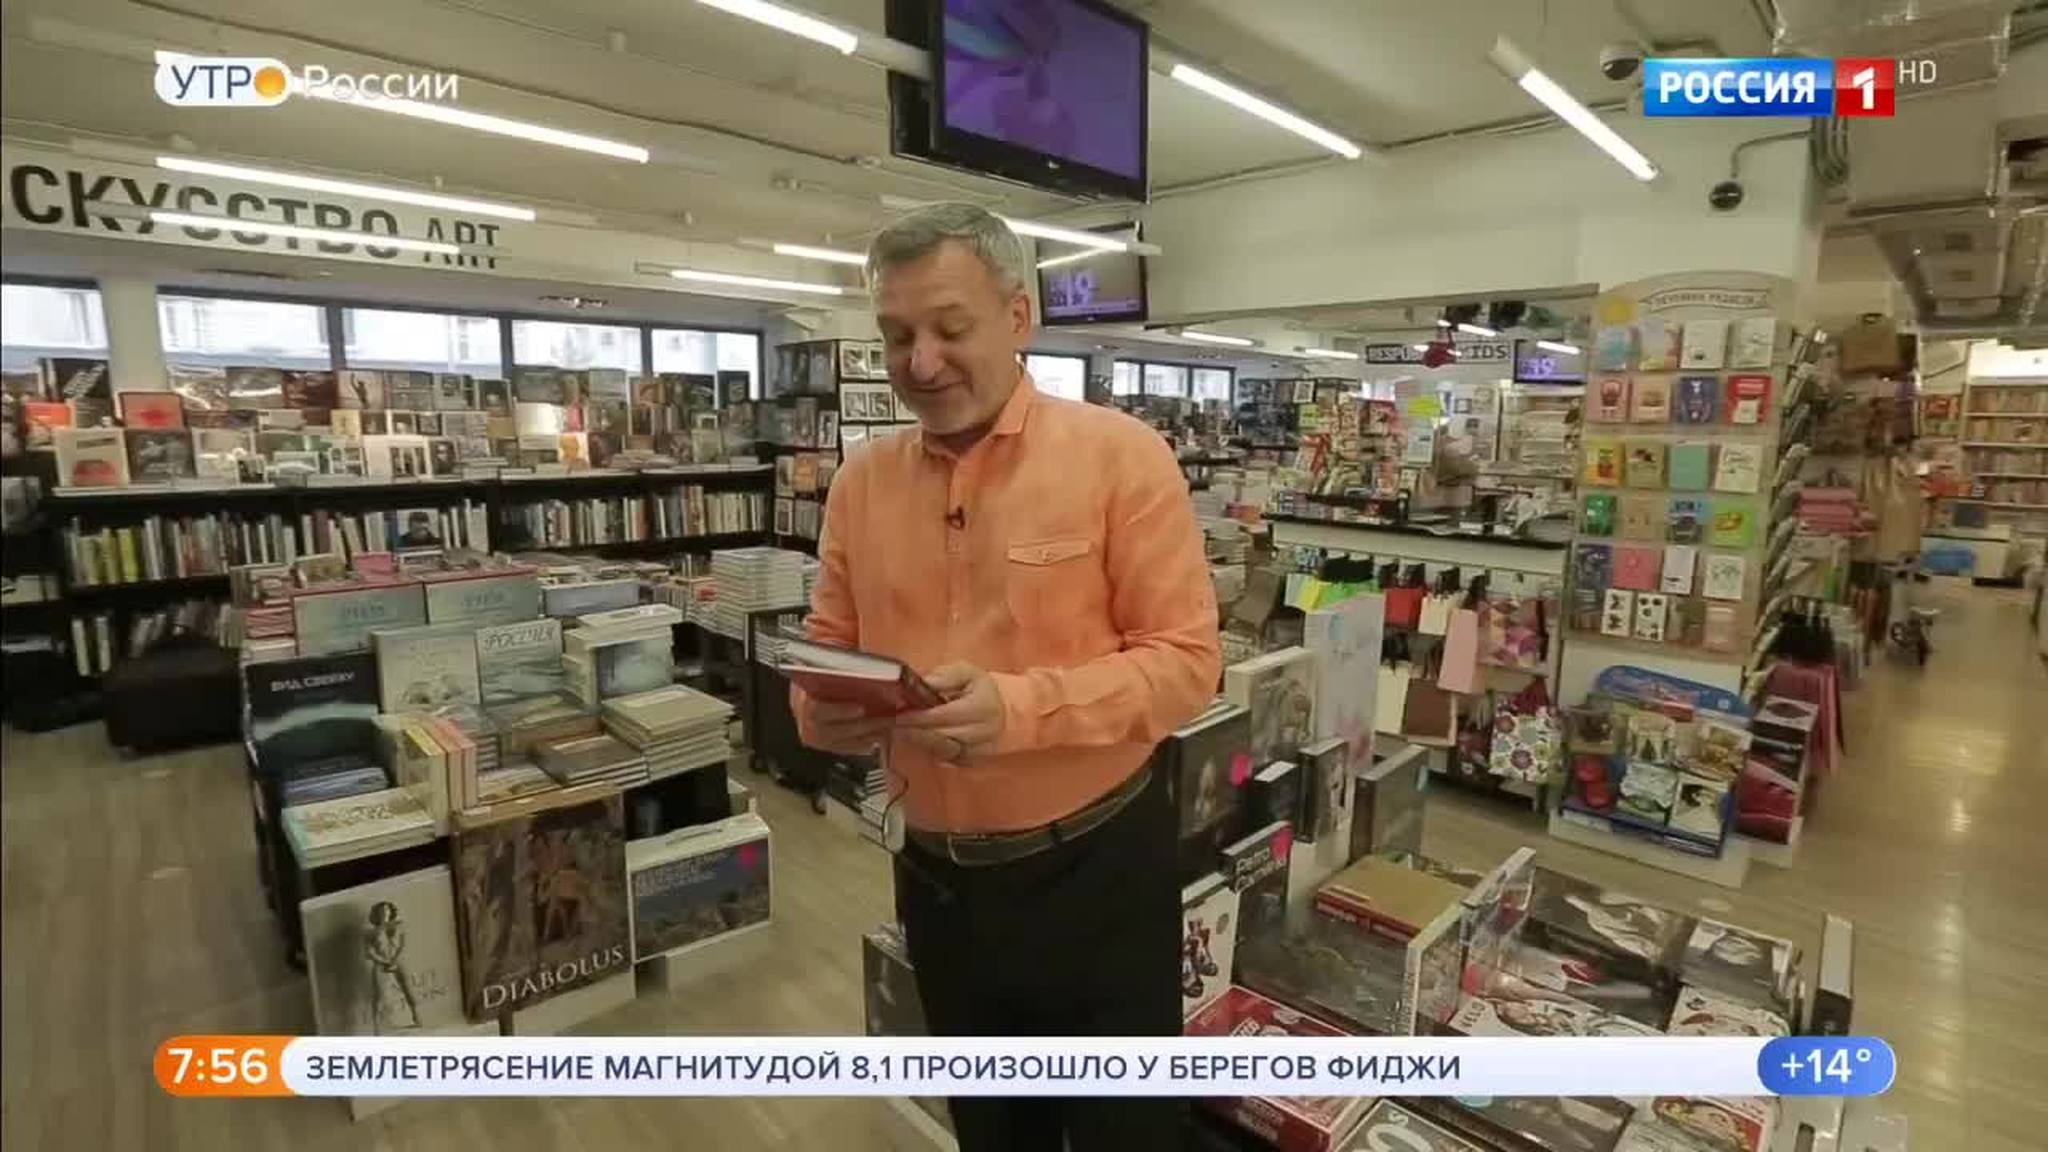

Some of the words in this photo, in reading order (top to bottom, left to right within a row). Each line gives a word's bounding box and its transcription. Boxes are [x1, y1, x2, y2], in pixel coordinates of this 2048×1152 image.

[10, 164, 398, 259] СКУССТВО
[423, 217, 501, 269] ART
[482, 943, 624, 1009] DIABOLUS
